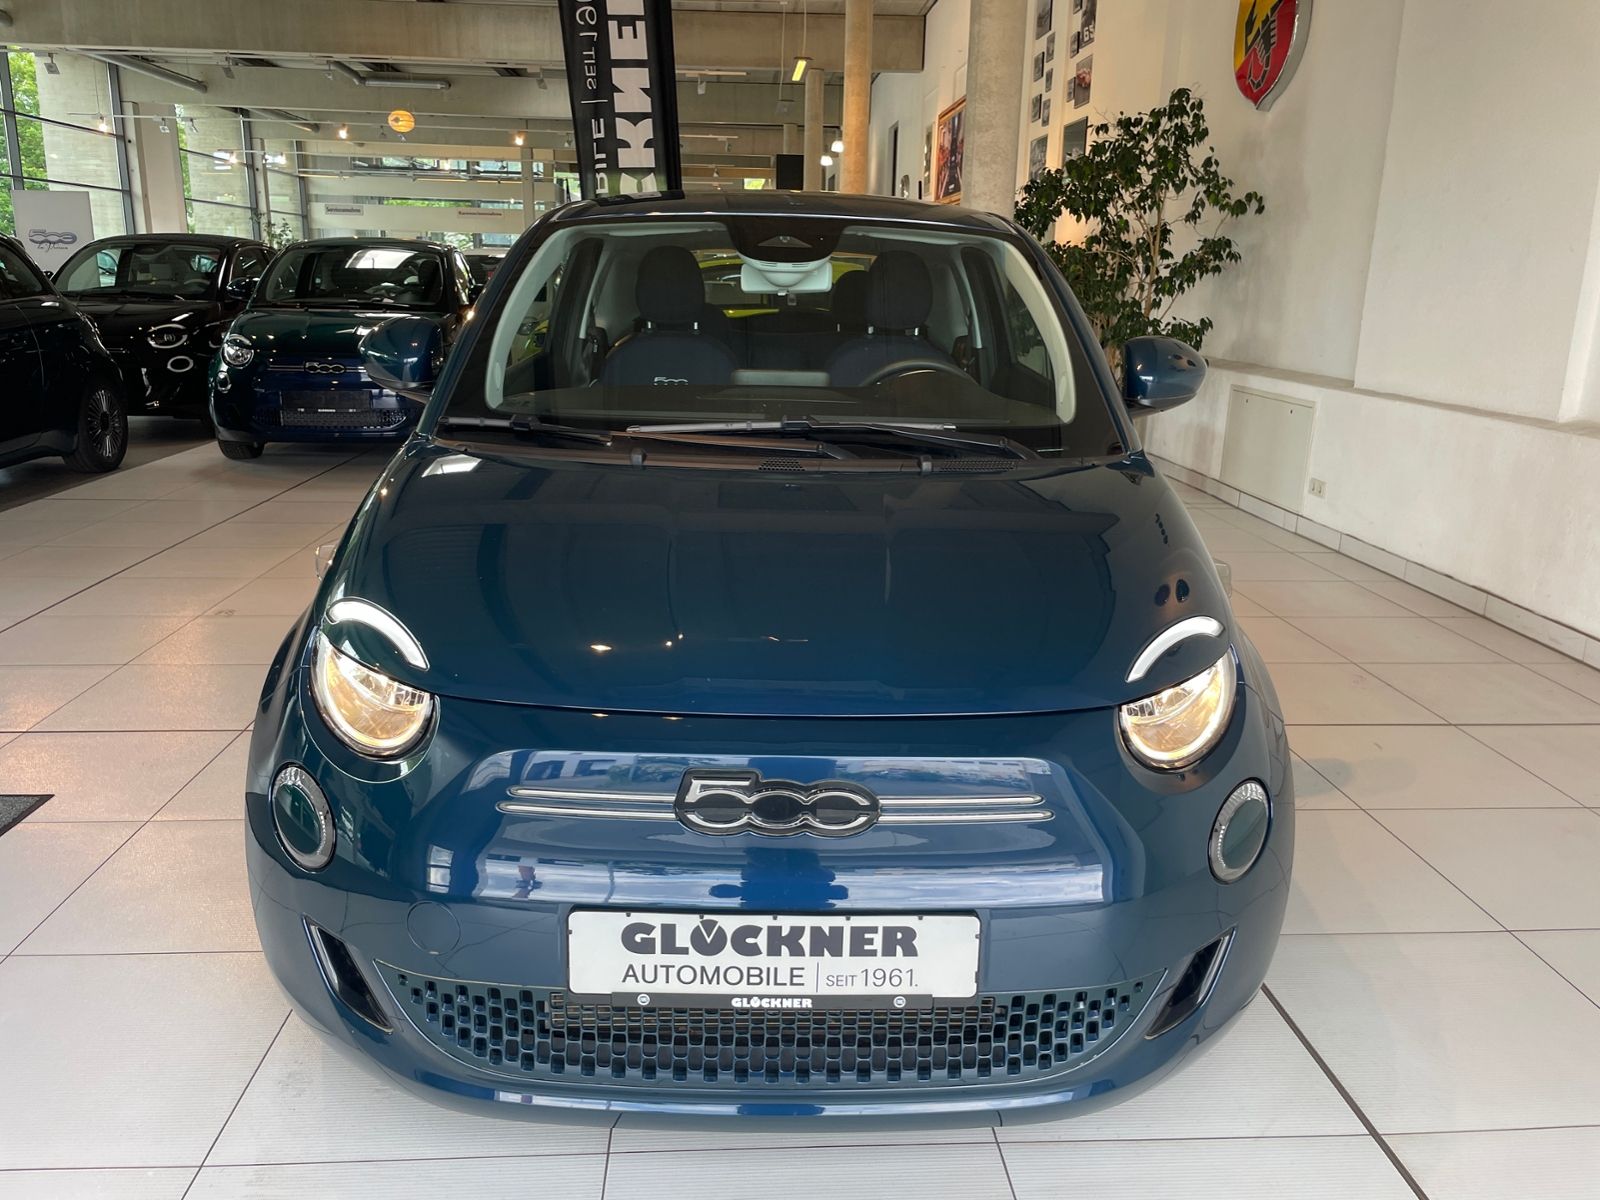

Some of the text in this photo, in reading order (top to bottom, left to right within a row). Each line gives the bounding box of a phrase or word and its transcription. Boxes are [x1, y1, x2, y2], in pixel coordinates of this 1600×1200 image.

[680, 773, 875, 833] 500
[621, 963, 918, 988] AUTOMOBILE SEIT 1961.
